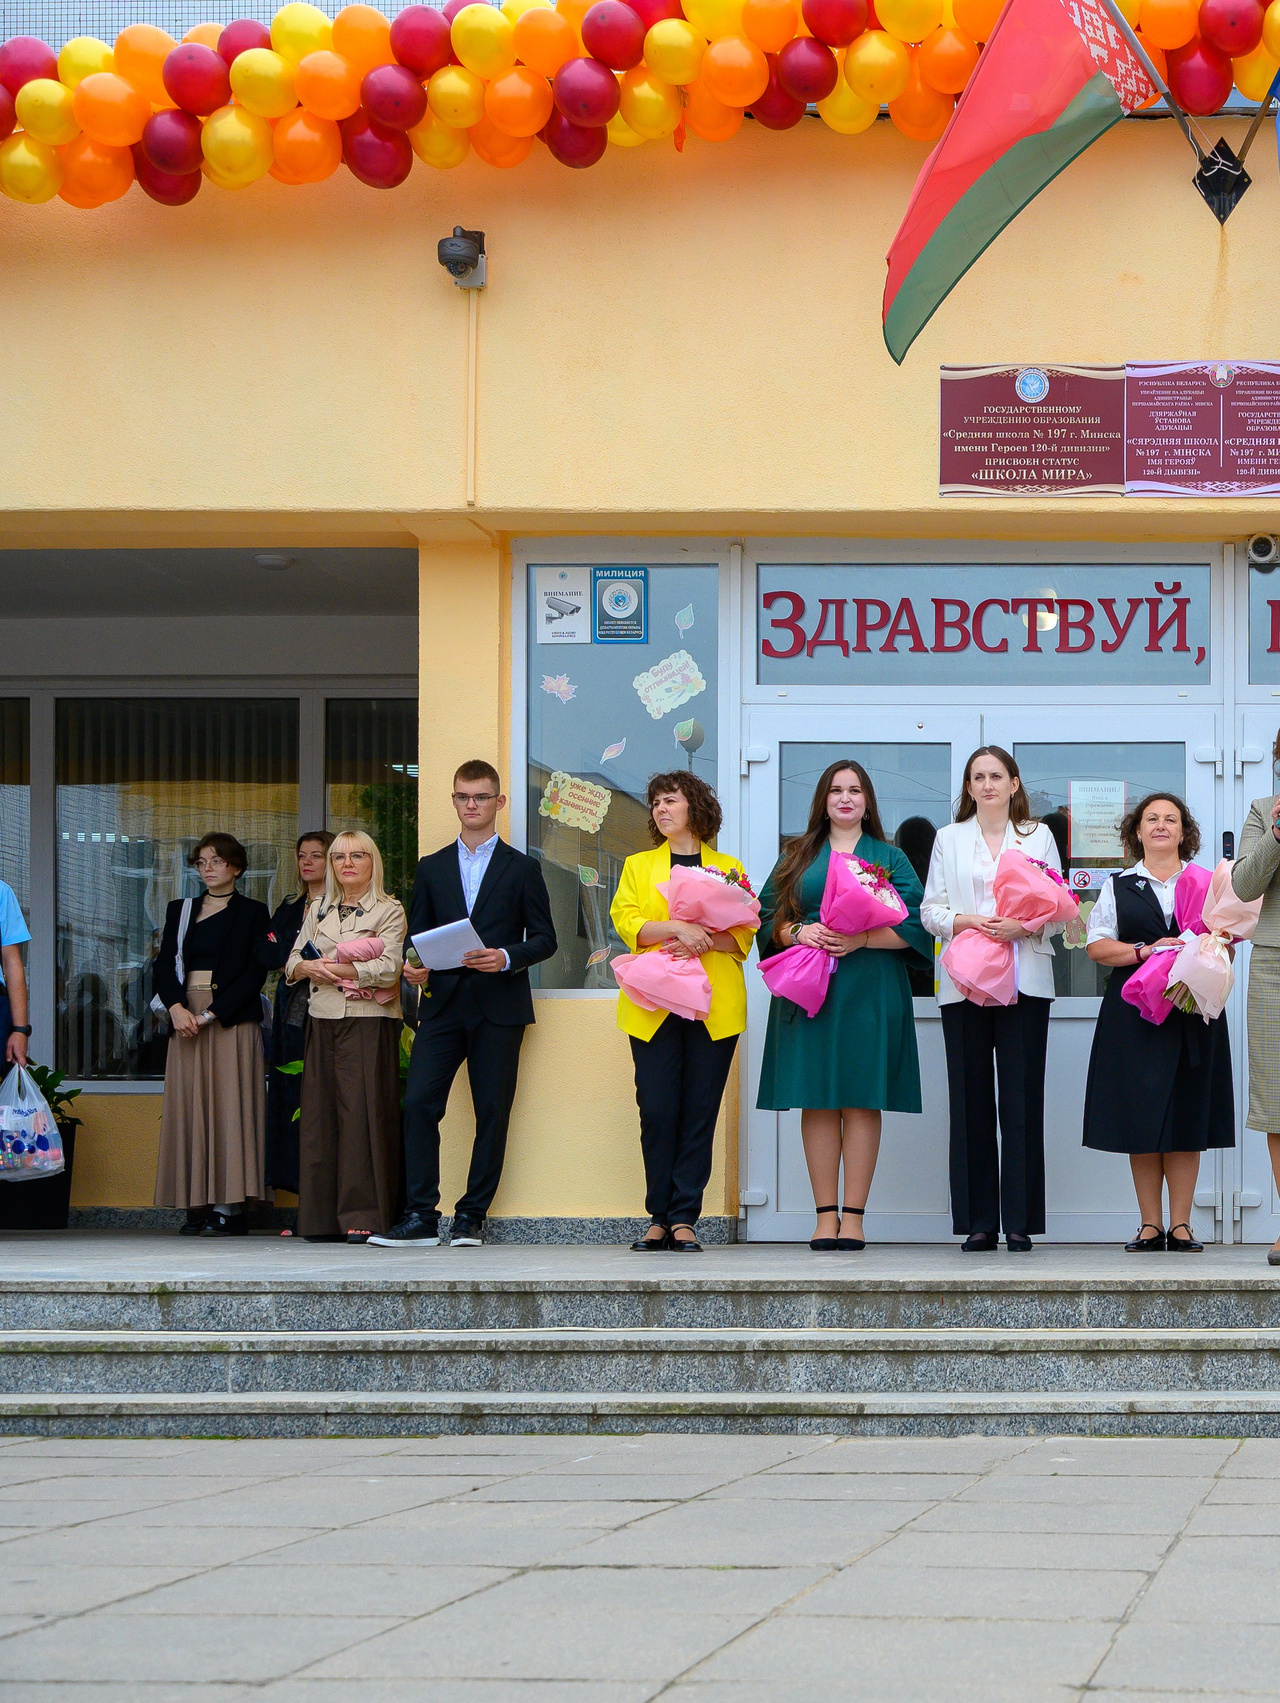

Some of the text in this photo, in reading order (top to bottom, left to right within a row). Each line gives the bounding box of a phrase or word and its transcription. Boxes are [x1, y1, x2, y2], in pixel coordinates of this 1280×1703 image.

[983, 406, 1082, 414] ГОСУДАРСТВЕННОМУ
[964, 416, 1101, 424] УЧРЕЖДЕНИЮ ОБРАЗОВАНИЯ
[943, 429, 993, 439] «Средняя
[996, 430, 1030, 439] школа
[1033, 430, 1044, 439] №
[1047, 429, 1067, 439] 197
[1080, 430, 1121, 439] Минска
[1127, 438, 1182, 446] «СЯРЭДНЯЯ
[1224, 438, 1276, 446] «СРЕДНЯЯ
[990, 444, 1028, 453] Героев
[1031, 443, 1058, 452] 120-й
[1060, 445, 1110, 453] дивизии»
[1173, 448, 1211, 456] МІНСКА
[985, 458, 1079, 466] ПРИСВОЕН СТАТУС
[971, 469, 1093, 480] «ШКОЛА МИРА»
[1236, 467, 1256, 475] 120-Й
[596, 570, 644, 578] МИЛИЦИЯ
[762, 581, 1206, 666] ЗДРАВСТВУЙ,
[569, 781, 606, 801] уже жду
[568, 791, 601, 808] осенние
